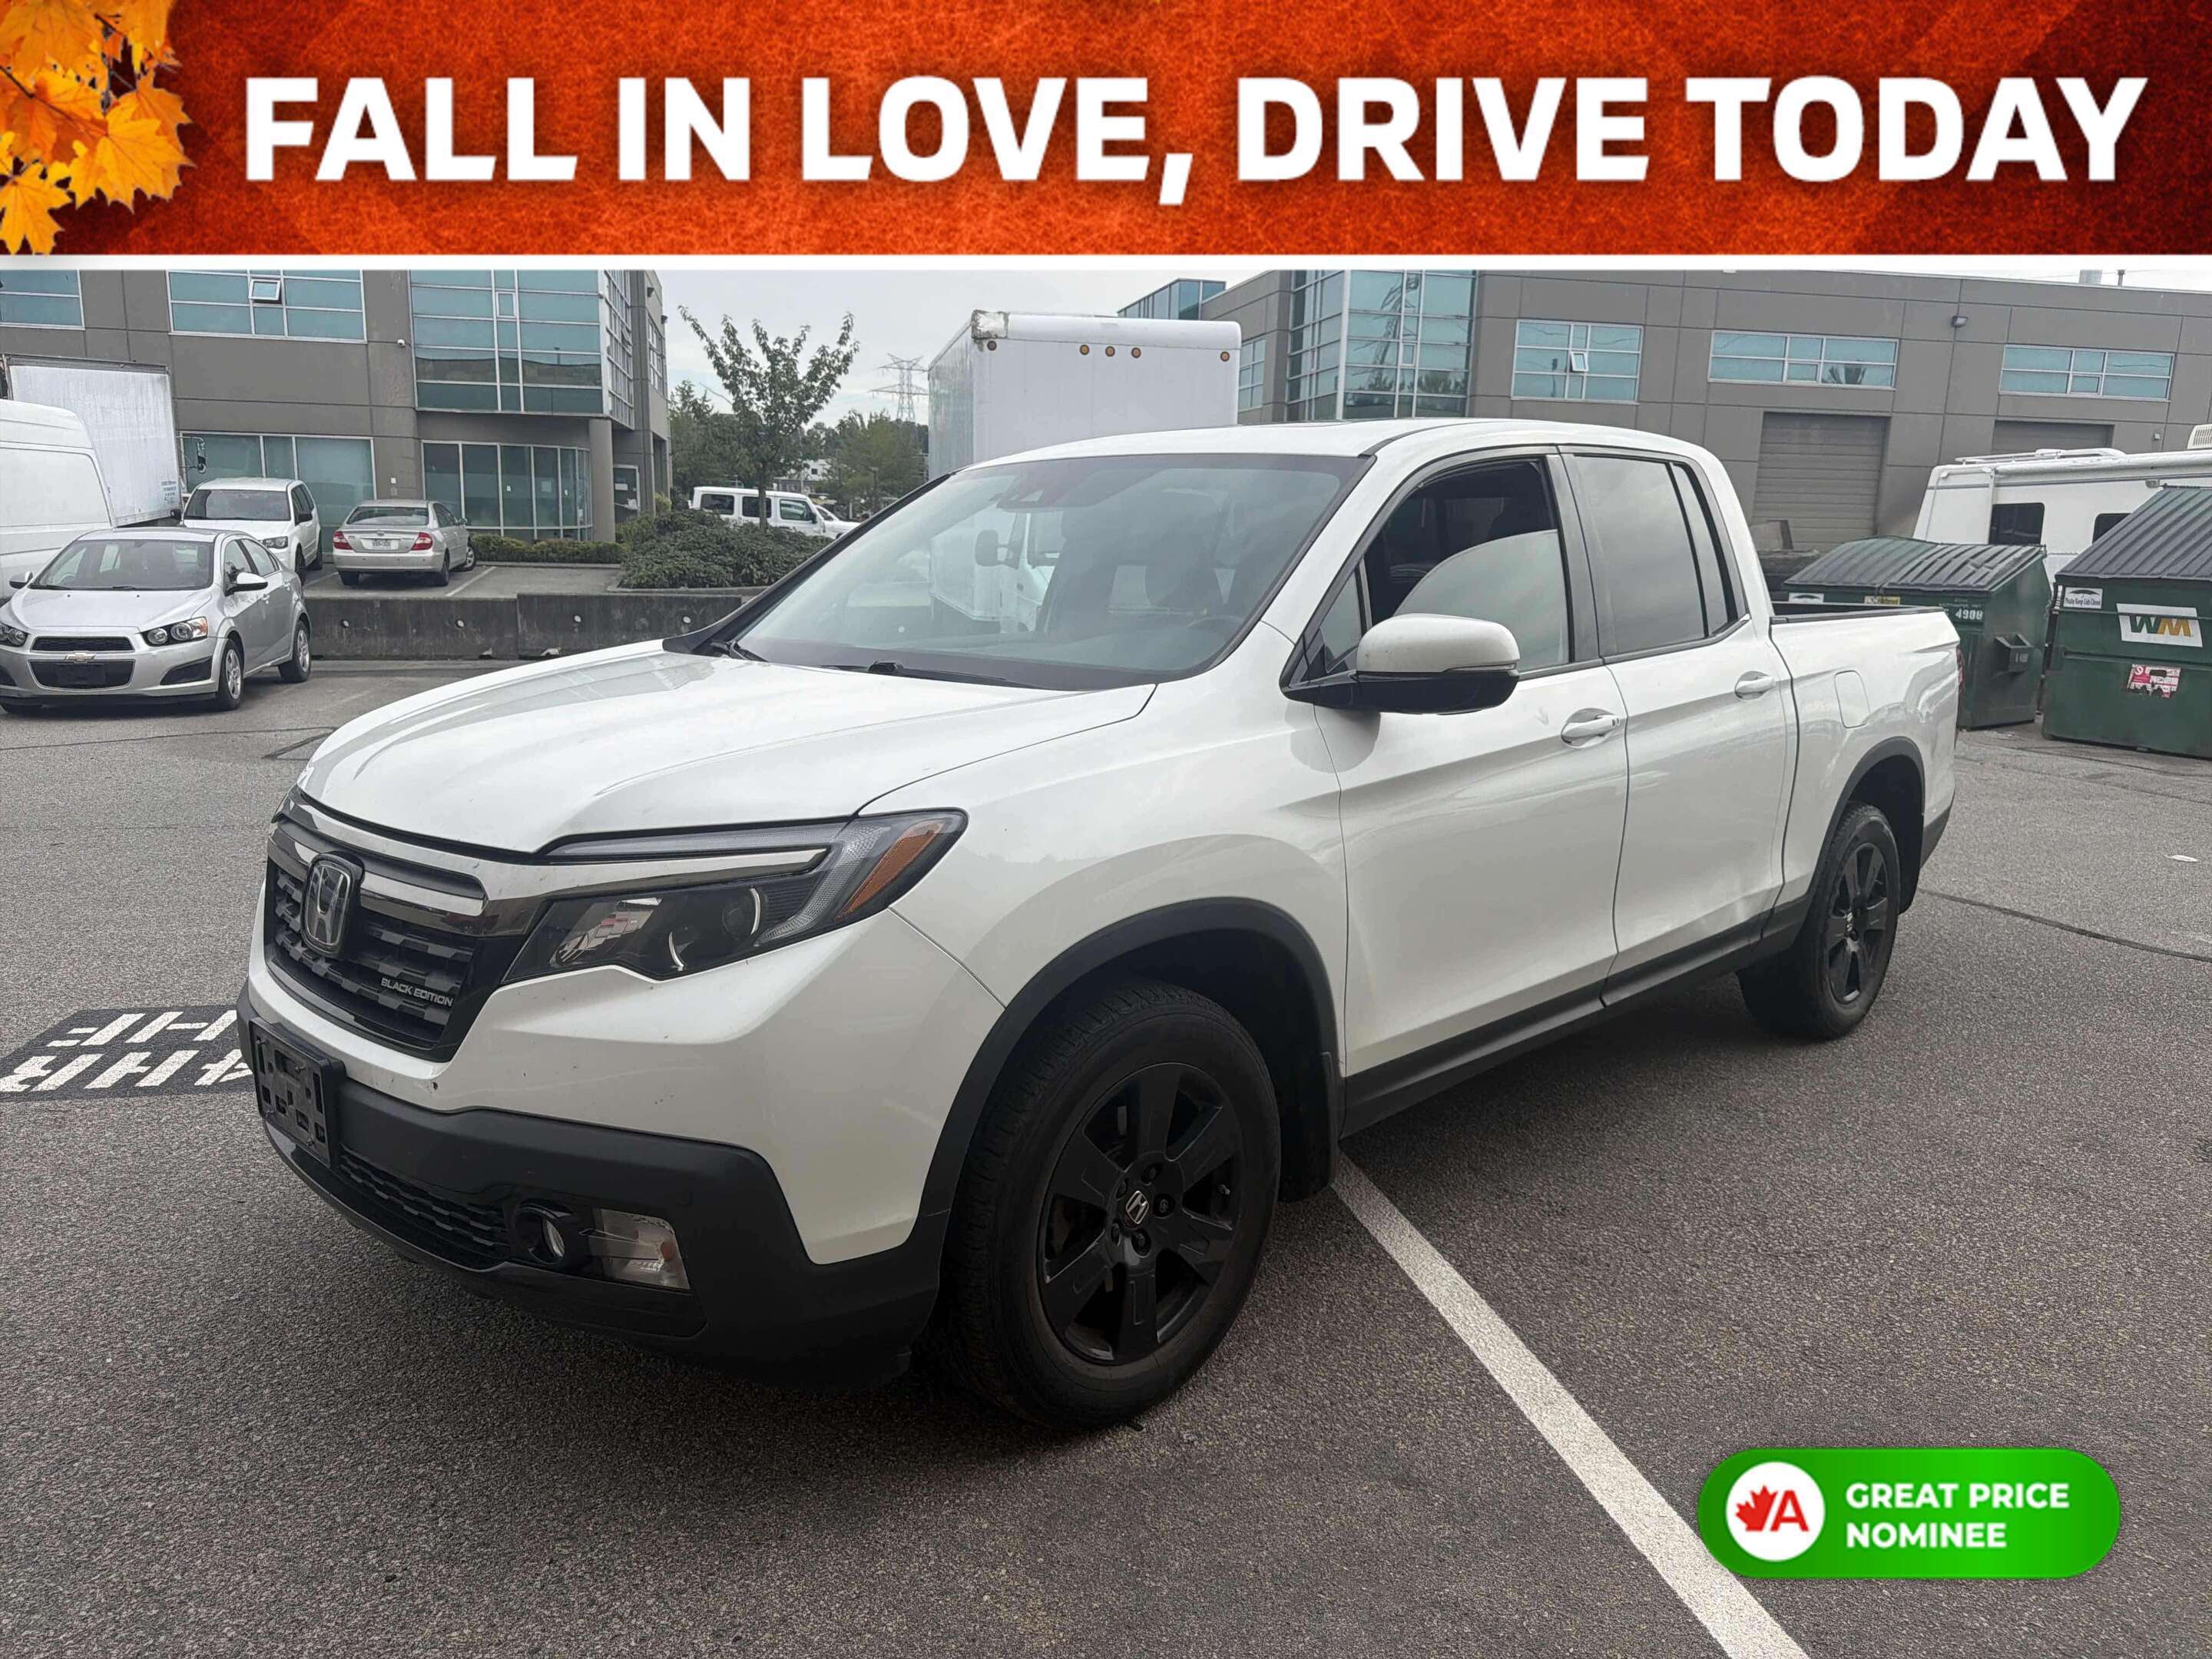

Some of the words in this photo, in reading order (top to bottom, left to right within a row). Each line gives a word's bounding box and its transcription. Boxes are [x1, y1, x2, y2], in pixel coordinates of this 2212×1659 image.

[2128, 614, 2191, 637] WM
[380, 977, 413, 995] BLACK
[413, 988, 454, 1007] EDITION
